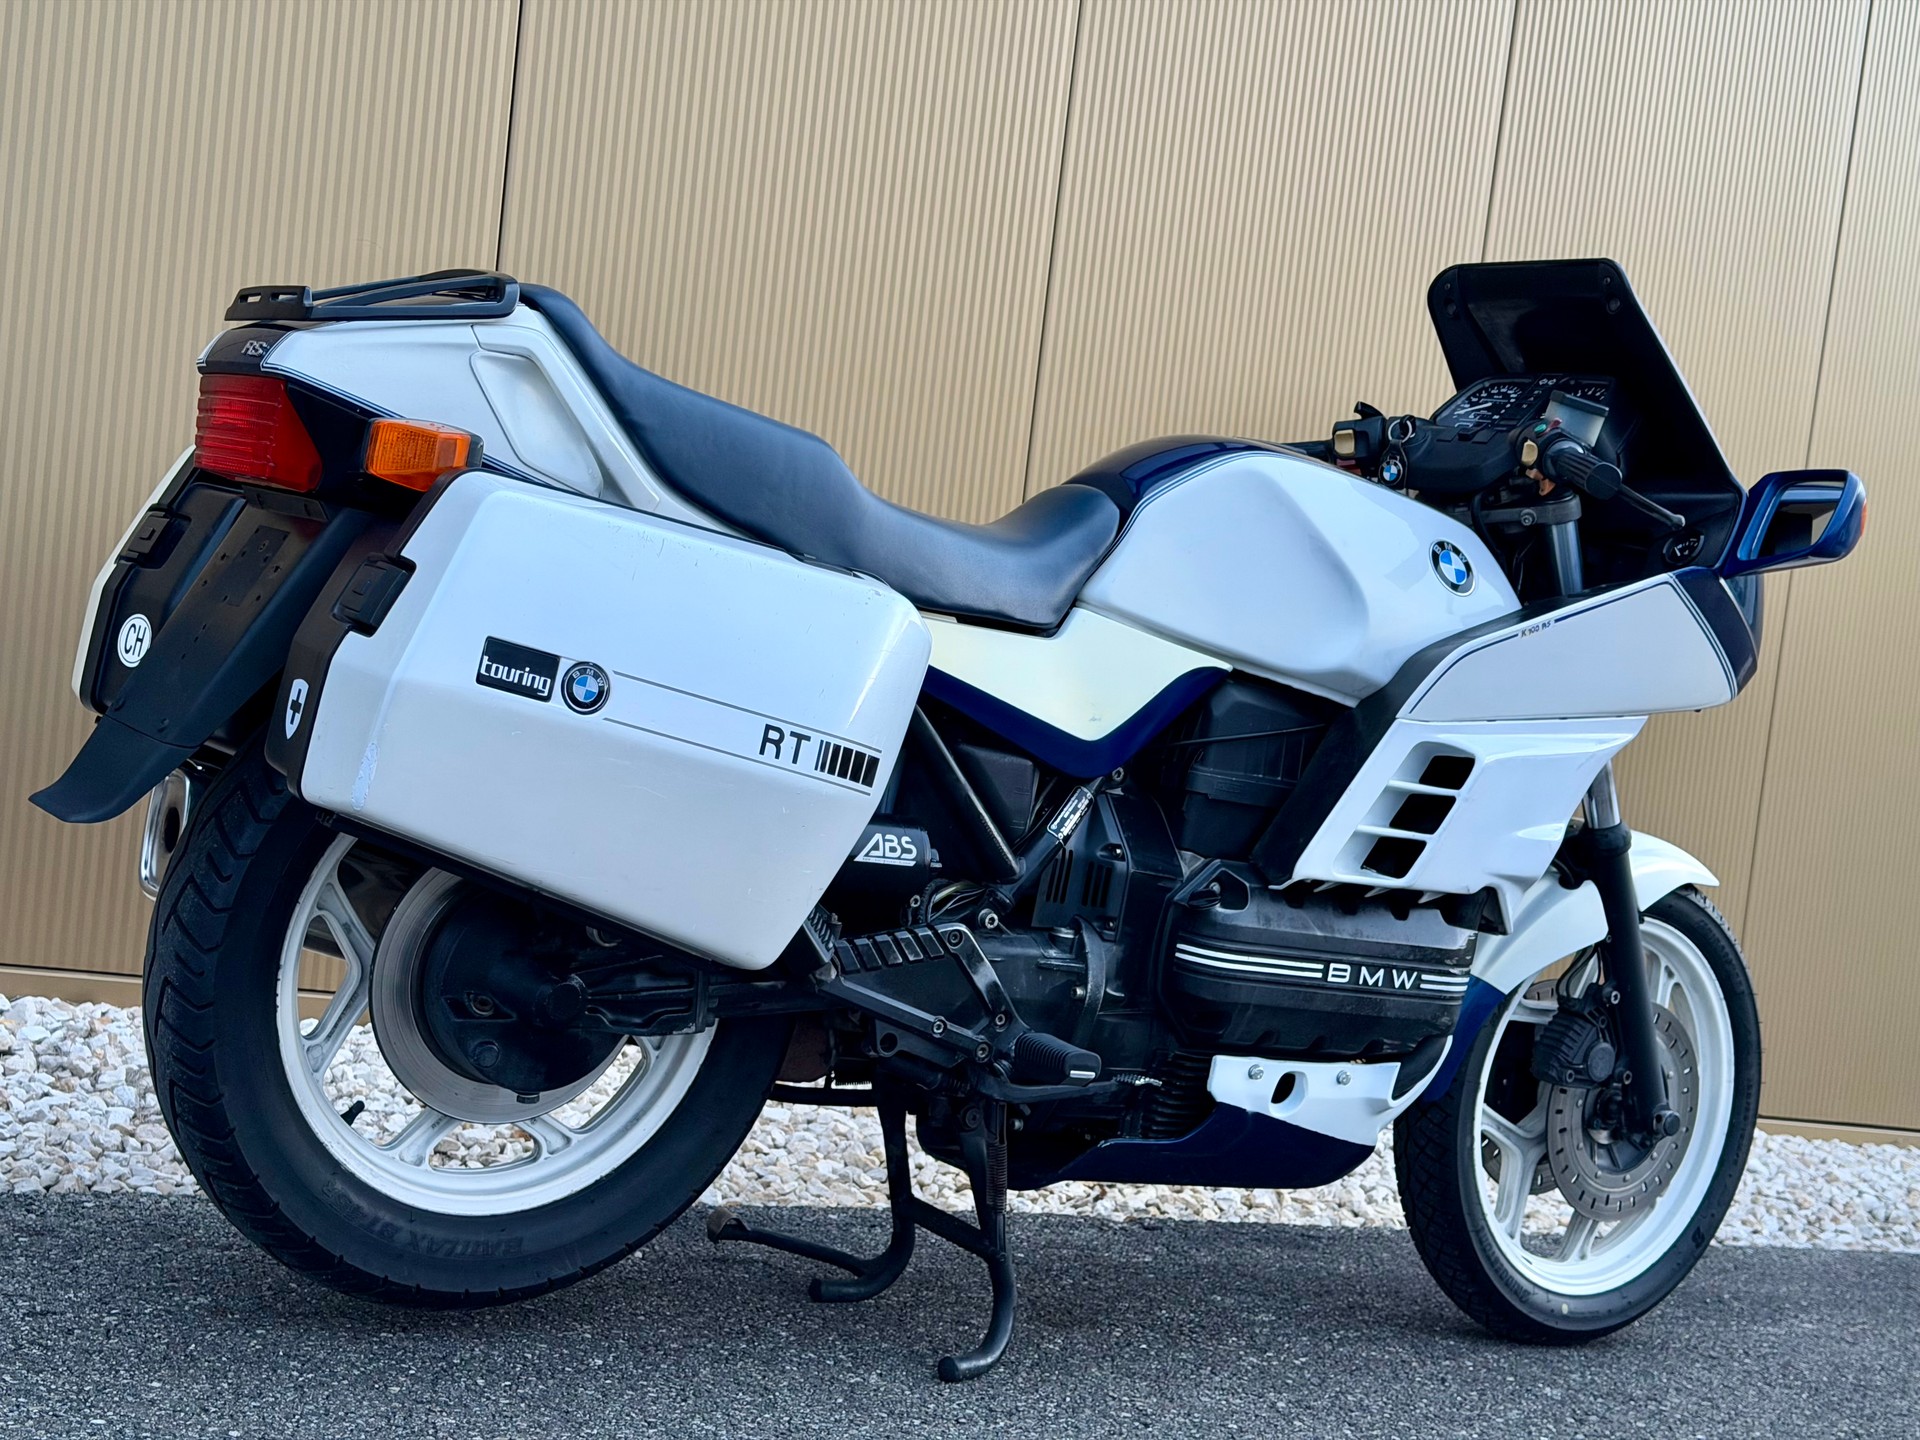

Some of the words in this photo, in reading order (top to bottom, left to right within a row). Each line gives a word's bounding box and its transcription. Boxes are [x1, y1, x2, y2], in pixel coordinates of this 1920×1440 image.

[124, 623, 148, 658] CH
[1521, 628, 1527, 638] K
[479, 655, 552, 697] touring
[758, 723, 812, 765] RT
[853, 832, 918, 867] ABS
[1327, 962, 1418, 990] BMW
